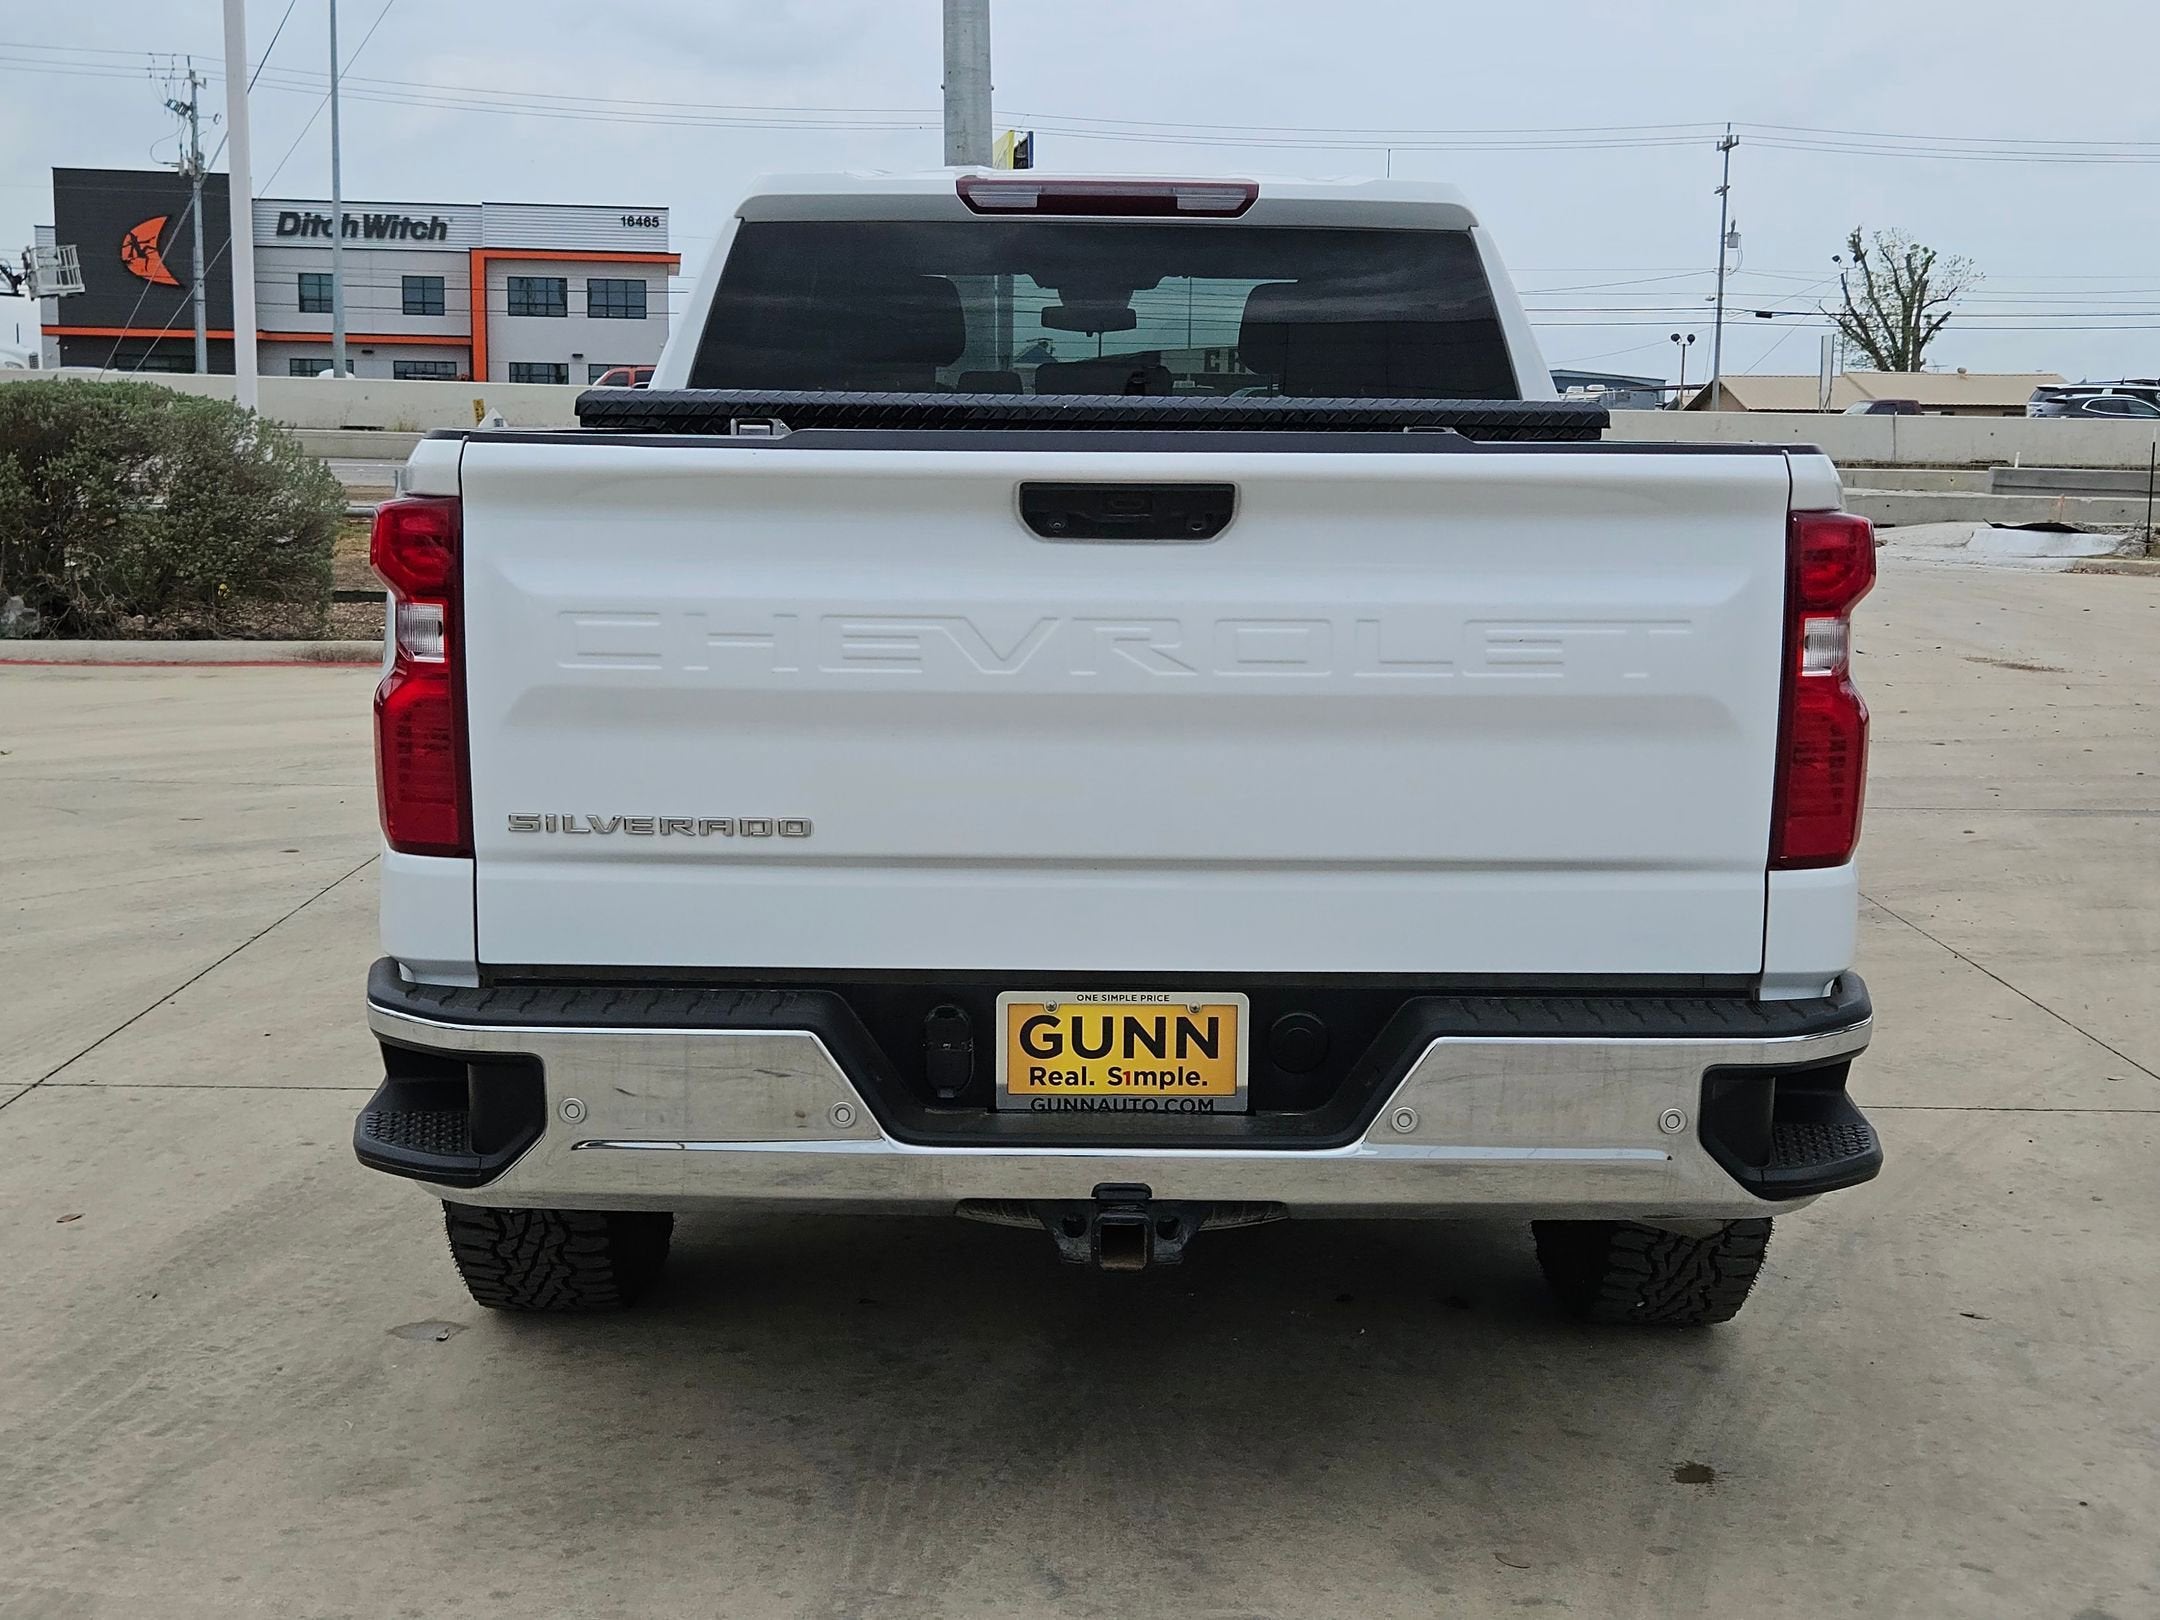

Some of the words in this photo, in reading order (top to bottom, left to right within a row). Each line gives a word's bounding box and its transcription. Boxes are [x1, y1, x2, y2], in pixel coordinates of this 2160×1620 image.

[276, 211, 359, 238] Ditch
[363, 213, 448, 240] Witch
[620, 215, 660, 228] 16465
[557, 609, 1693, 679] CHEVROLET
[508, 812, 812, 838] SILVERADO
[1076, 993, 1100, 1002] ONE
[1101, 993, 1137, 1002] SIMPLE
[1140, 994, 1170, 1003] PRICE
[1019, 1014, 1219, 1059] GUNN
[1029, 1066, 1095, 1087] Real.
[1030, 1097, 1214, 1113] GUNNAUTO.COM
